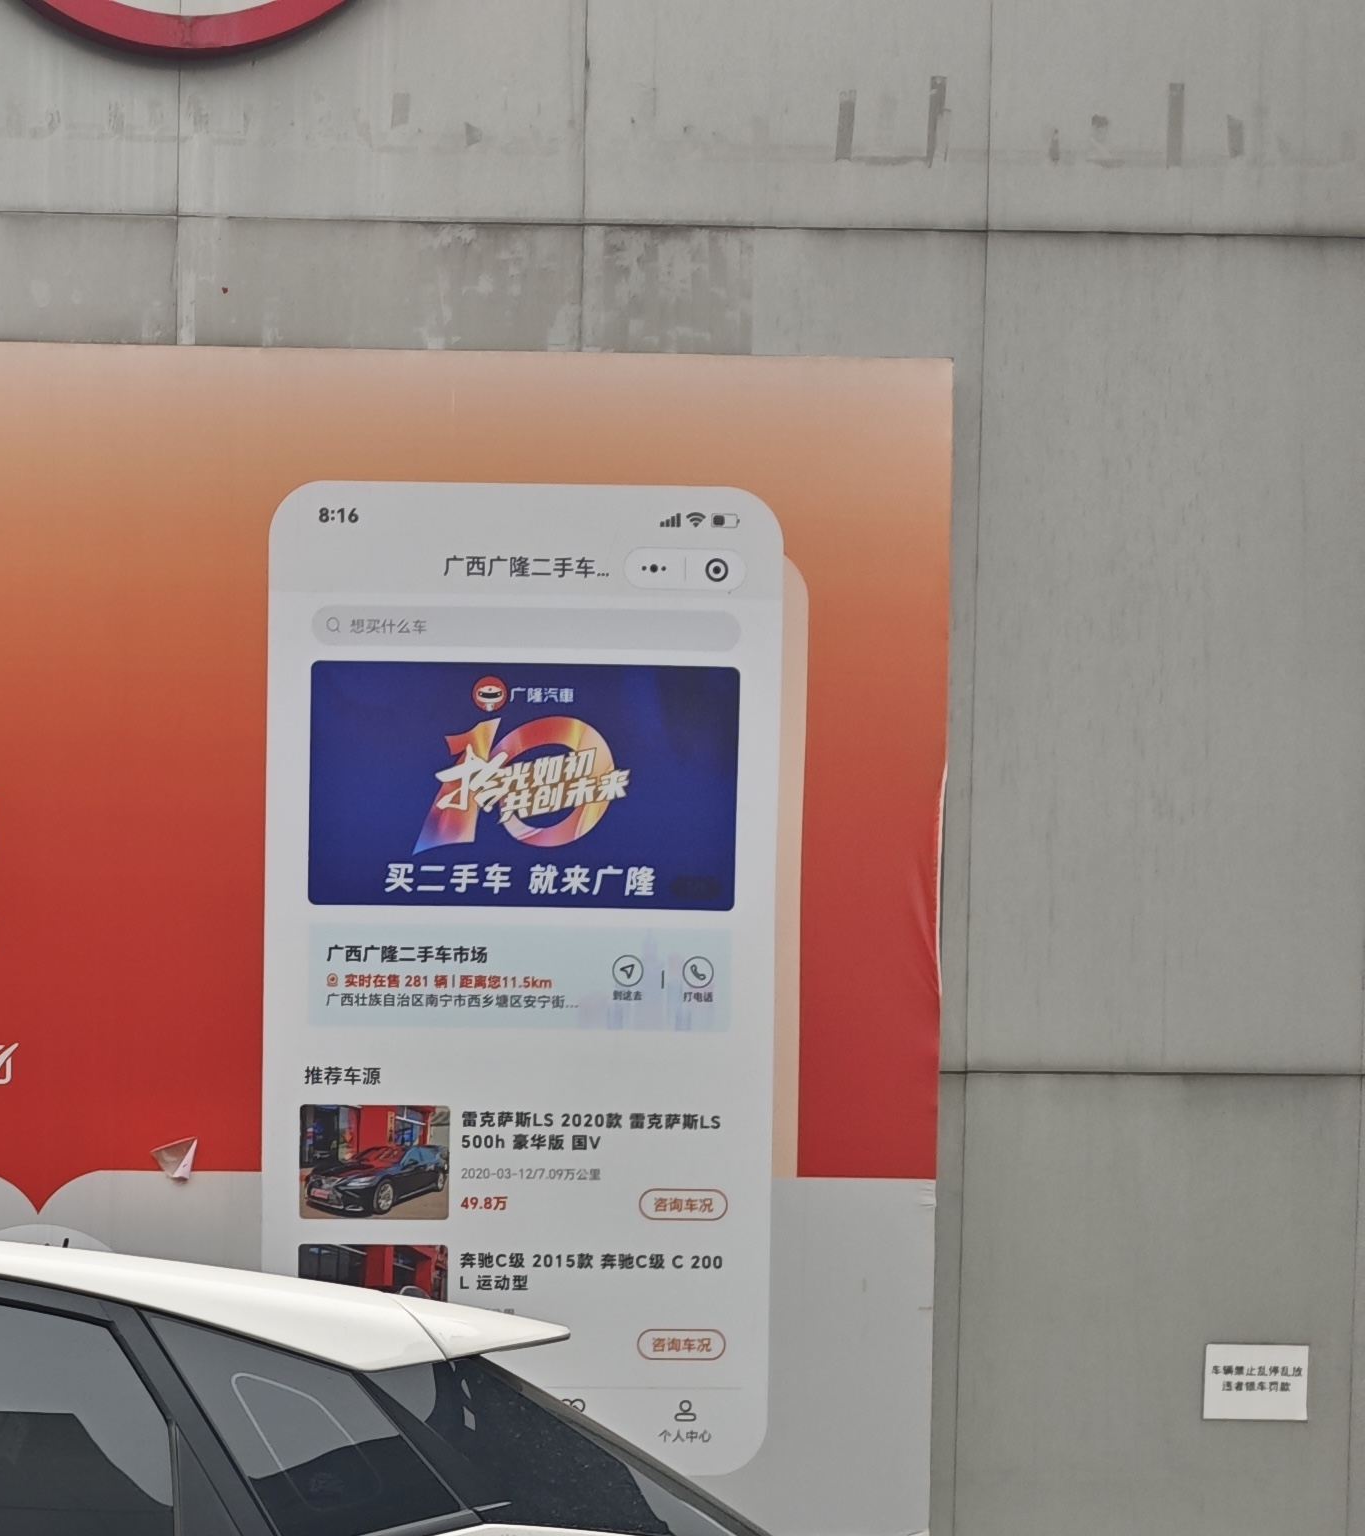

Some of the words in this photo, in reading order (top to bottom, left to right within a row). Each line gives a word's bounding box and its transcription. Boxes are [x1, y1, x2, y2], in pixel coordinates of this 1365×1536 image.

[318, 507, 360, 525] 8:16
[349, 617, 428, 636] 想买什么车
[498, 768, 631, 824] 共创未来
[384, 864, 512, 894] 买二手车
[528, 865, 656, 897] 就来广隆
[326, 944, 488, 964] 广西广隆二手车市场
[344, 973, 400, 988] 实时在售
[405, 974, 429, 988] 281
[434, 974, 448, 989] 辆
[683, 991, 714, 1003] 打电话
[304, 1066, 381, 1086] 推荐车源
[462, 1111, 554, 1128] 雷克萨斯LS
[561, 1112, 622, 1129] 2020款
[629, 1113, 721, 1130] 雷克萨斯LS
[461, 1134, 505, 1150] 500h
[513, 1134, 565, 1151] 豪华版
[572, 1135, 602, 1151] 国V
[461, 1168, 602, 1182] 2020-03-12/7.09万公里
[460, 1196, 508, 1211] 49.8万
[654, 1197, 714, 1213] 咨询车况
[460, 1252, 525, 1269] 奔驰C级
[532, 1253, 594, 1270] 2015款
[600, 1253, 665, 1270] 奔驰C级
[672, 1255, 684, 1269] C
[691, 1255, 724, 1270] 200
[459, 1276, 470, 1290] L
[476, 1274, 529, 1291] 运动型
[651, 1337, 712, 1354] 咨询车况
[659, 1428, 712, 1444] 个人中心
